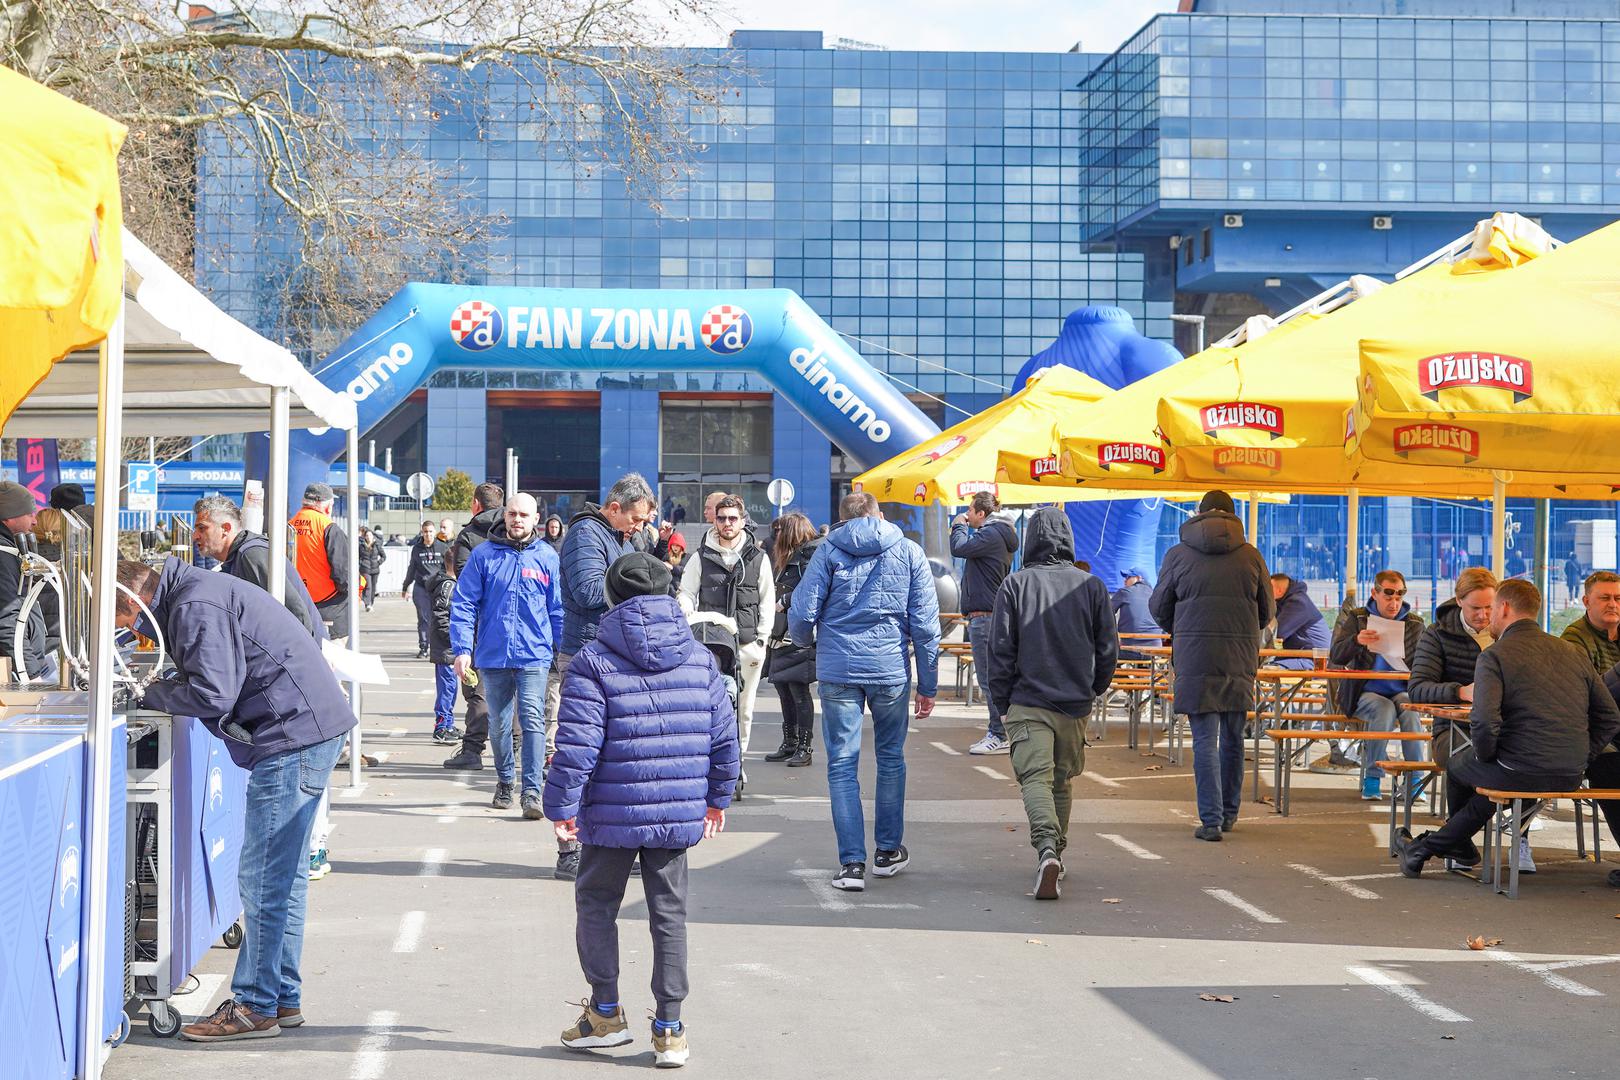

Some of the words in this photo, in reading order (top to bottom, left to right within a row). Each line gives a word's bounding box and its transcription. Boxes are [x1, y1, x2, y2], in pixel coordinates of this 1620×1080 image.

[507, 306, 582, 349] FAN
[590, 308, 695, 350] ZONA
[346, 342, 413, 401] amo
[1428, 354, 1524, 386] Ožujsko
[789, 343, 891, 443] dinamo
[1206, 403, 1277, 428] Ožujsko
[1104, 443, 1160, 464] Ožujsko
[136, 469, 149, 489] P
[190, 471, 241, 481] PRODAJA
